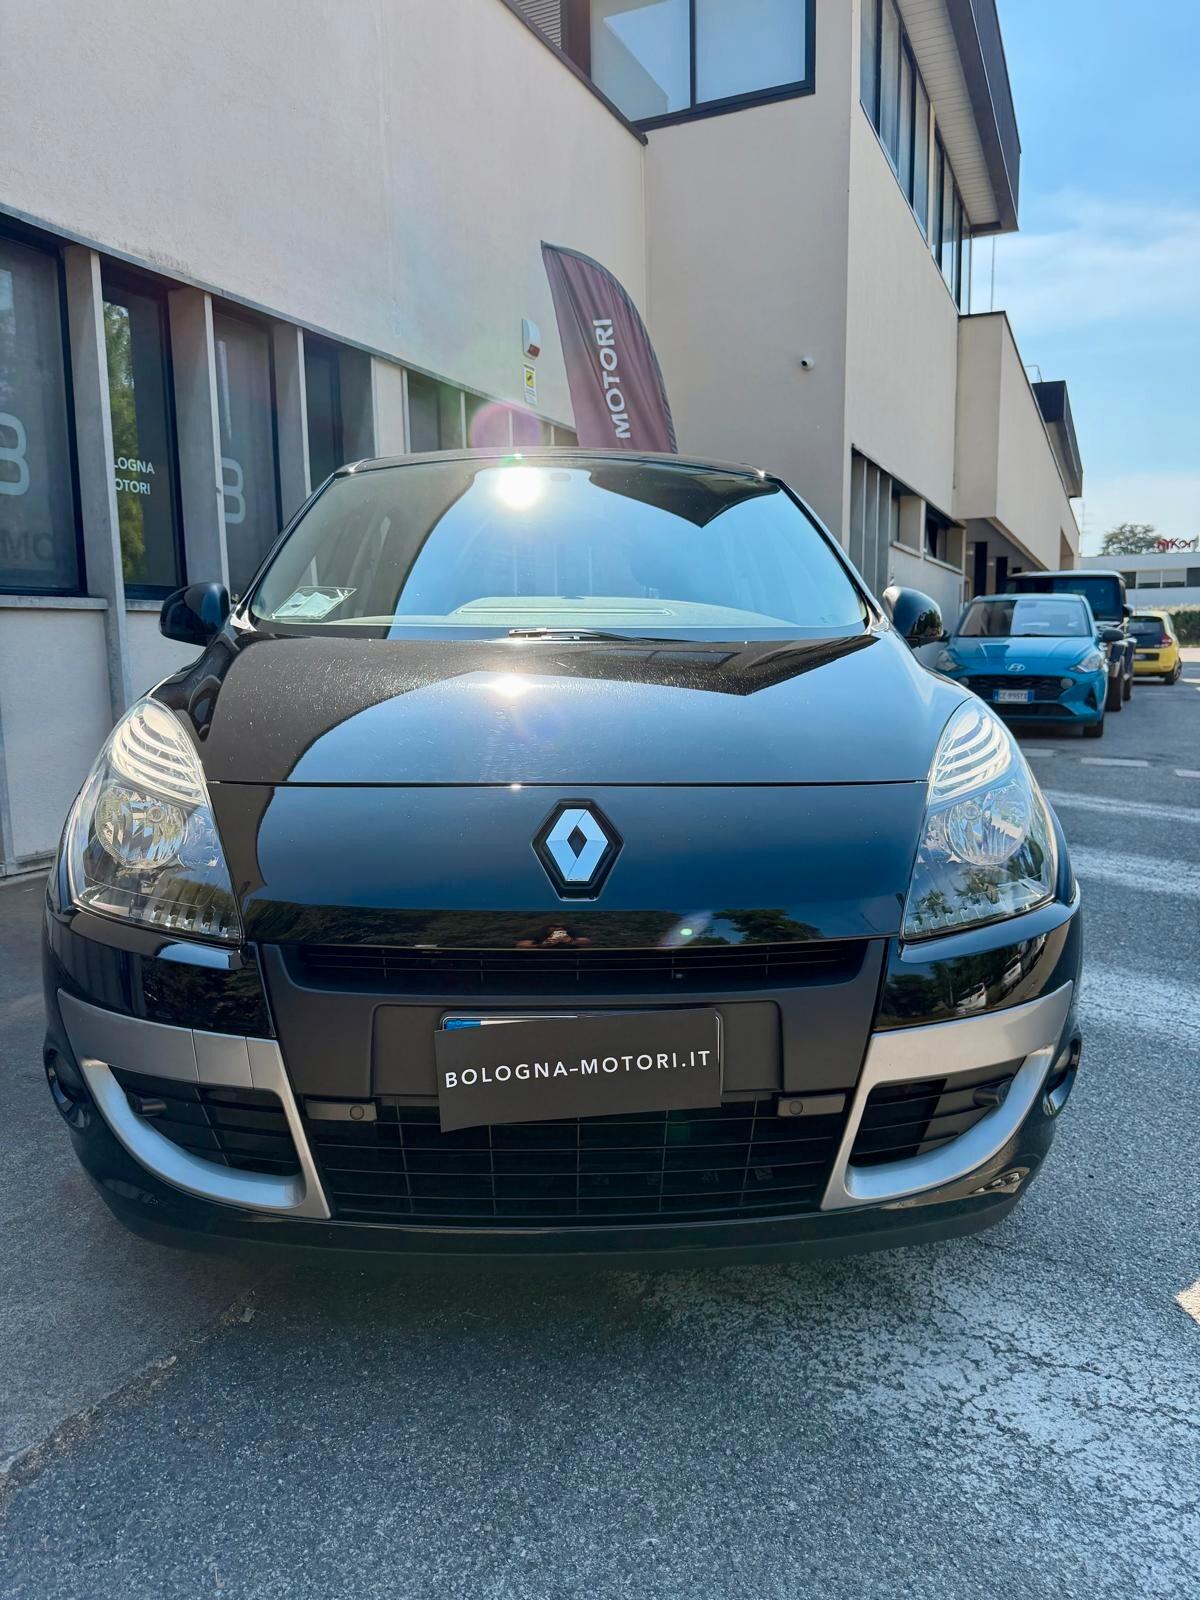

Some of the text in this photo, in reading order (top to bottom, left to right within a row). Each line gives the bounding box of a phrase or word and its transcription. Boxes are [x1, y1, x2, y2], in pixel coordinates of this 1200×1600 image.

[593, 318, 631, 439] MOTORI
[114, 456, 156, 475] OGNA
[445, 1050, 711, 1088] BOLOGNA-MOTORI.IT
